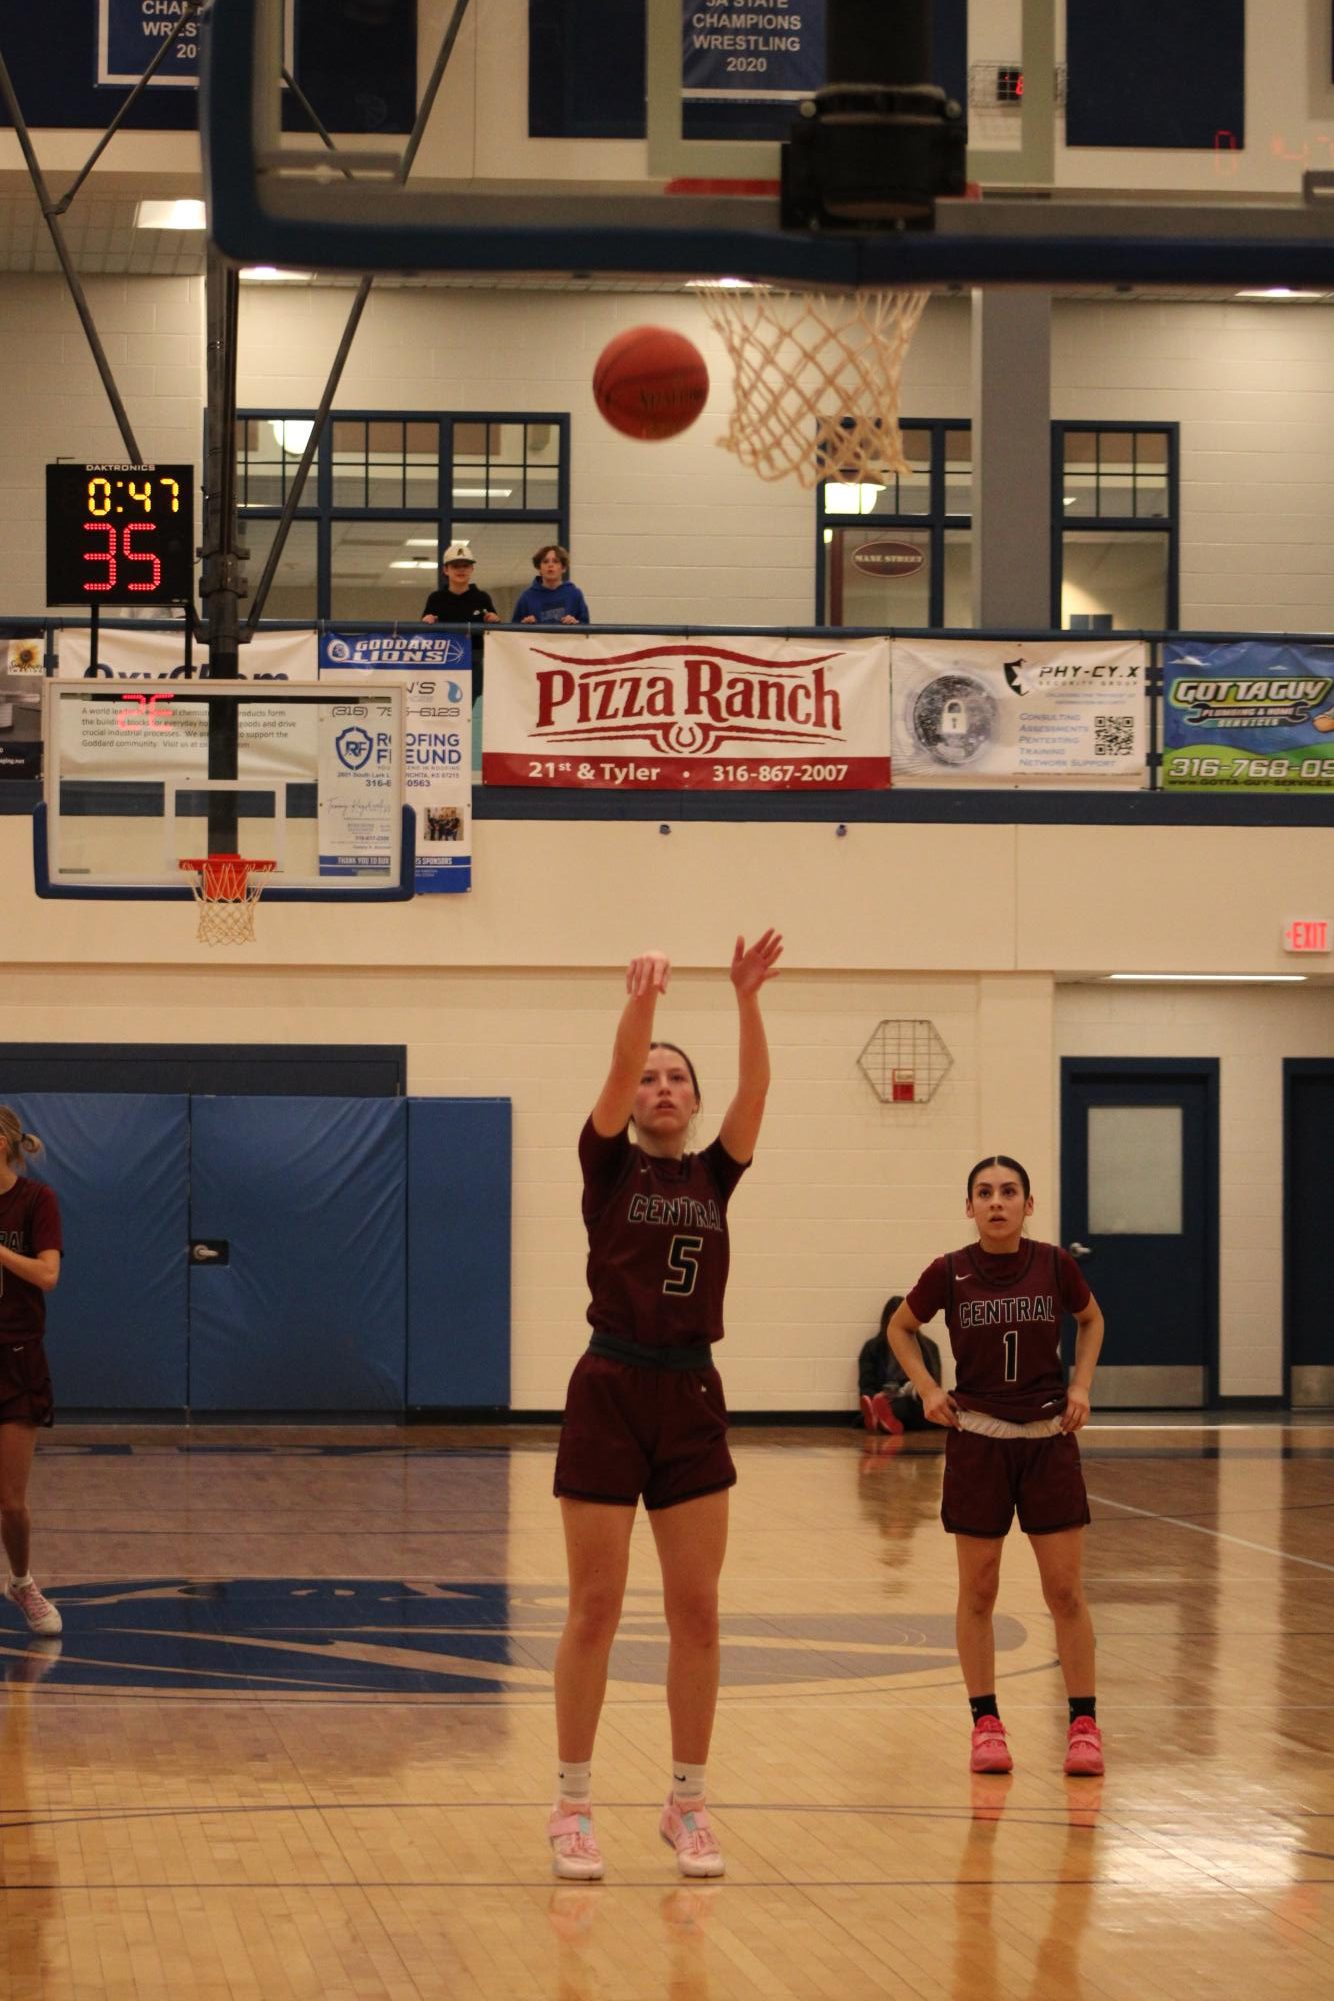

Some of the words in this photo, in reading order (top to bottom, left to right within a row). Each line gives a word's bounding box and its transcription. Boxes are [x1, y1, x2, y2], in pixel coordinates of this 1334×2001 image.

[692, 13, 802, 30] CHAMPIONS
[693, 35, 801, 52] WRESTLING
[726, 57, 768, 73] 2020
[85, 464, 156, 472] DAKTRONICS
[88, 477, 179, 516] 0:47
[83, 522, 161, 591] 35
[355, 640, 448, 651] GODDARD
[352, 651, 443, 663] LIONS
[1039, 666, 1140, 678] PHY-CY.X
[536, 669, 675, 728] Pizza
[684, 660, 842, 731] Ranch
[332, 706, 369, 718] (316)
[1217, 718, 1280, 728] SERVICES
[377, 733, 460, 747] ROFING
[377, 749, 462, 764] FEUND
[578, 763, 595, 780] &
[600, 764, 661, 783] Tyler
[712, 764, 849, 782] 316-867-2007
[1169, 758, 1334, 778] 316-768-05
[1292, 922, 1328, 949] EXIT
[663, 1235, 703, 1297] 5
[959, 1295, 1055, 1329] CENTRAL
[1003, 1330, 1018, 1382] 1
